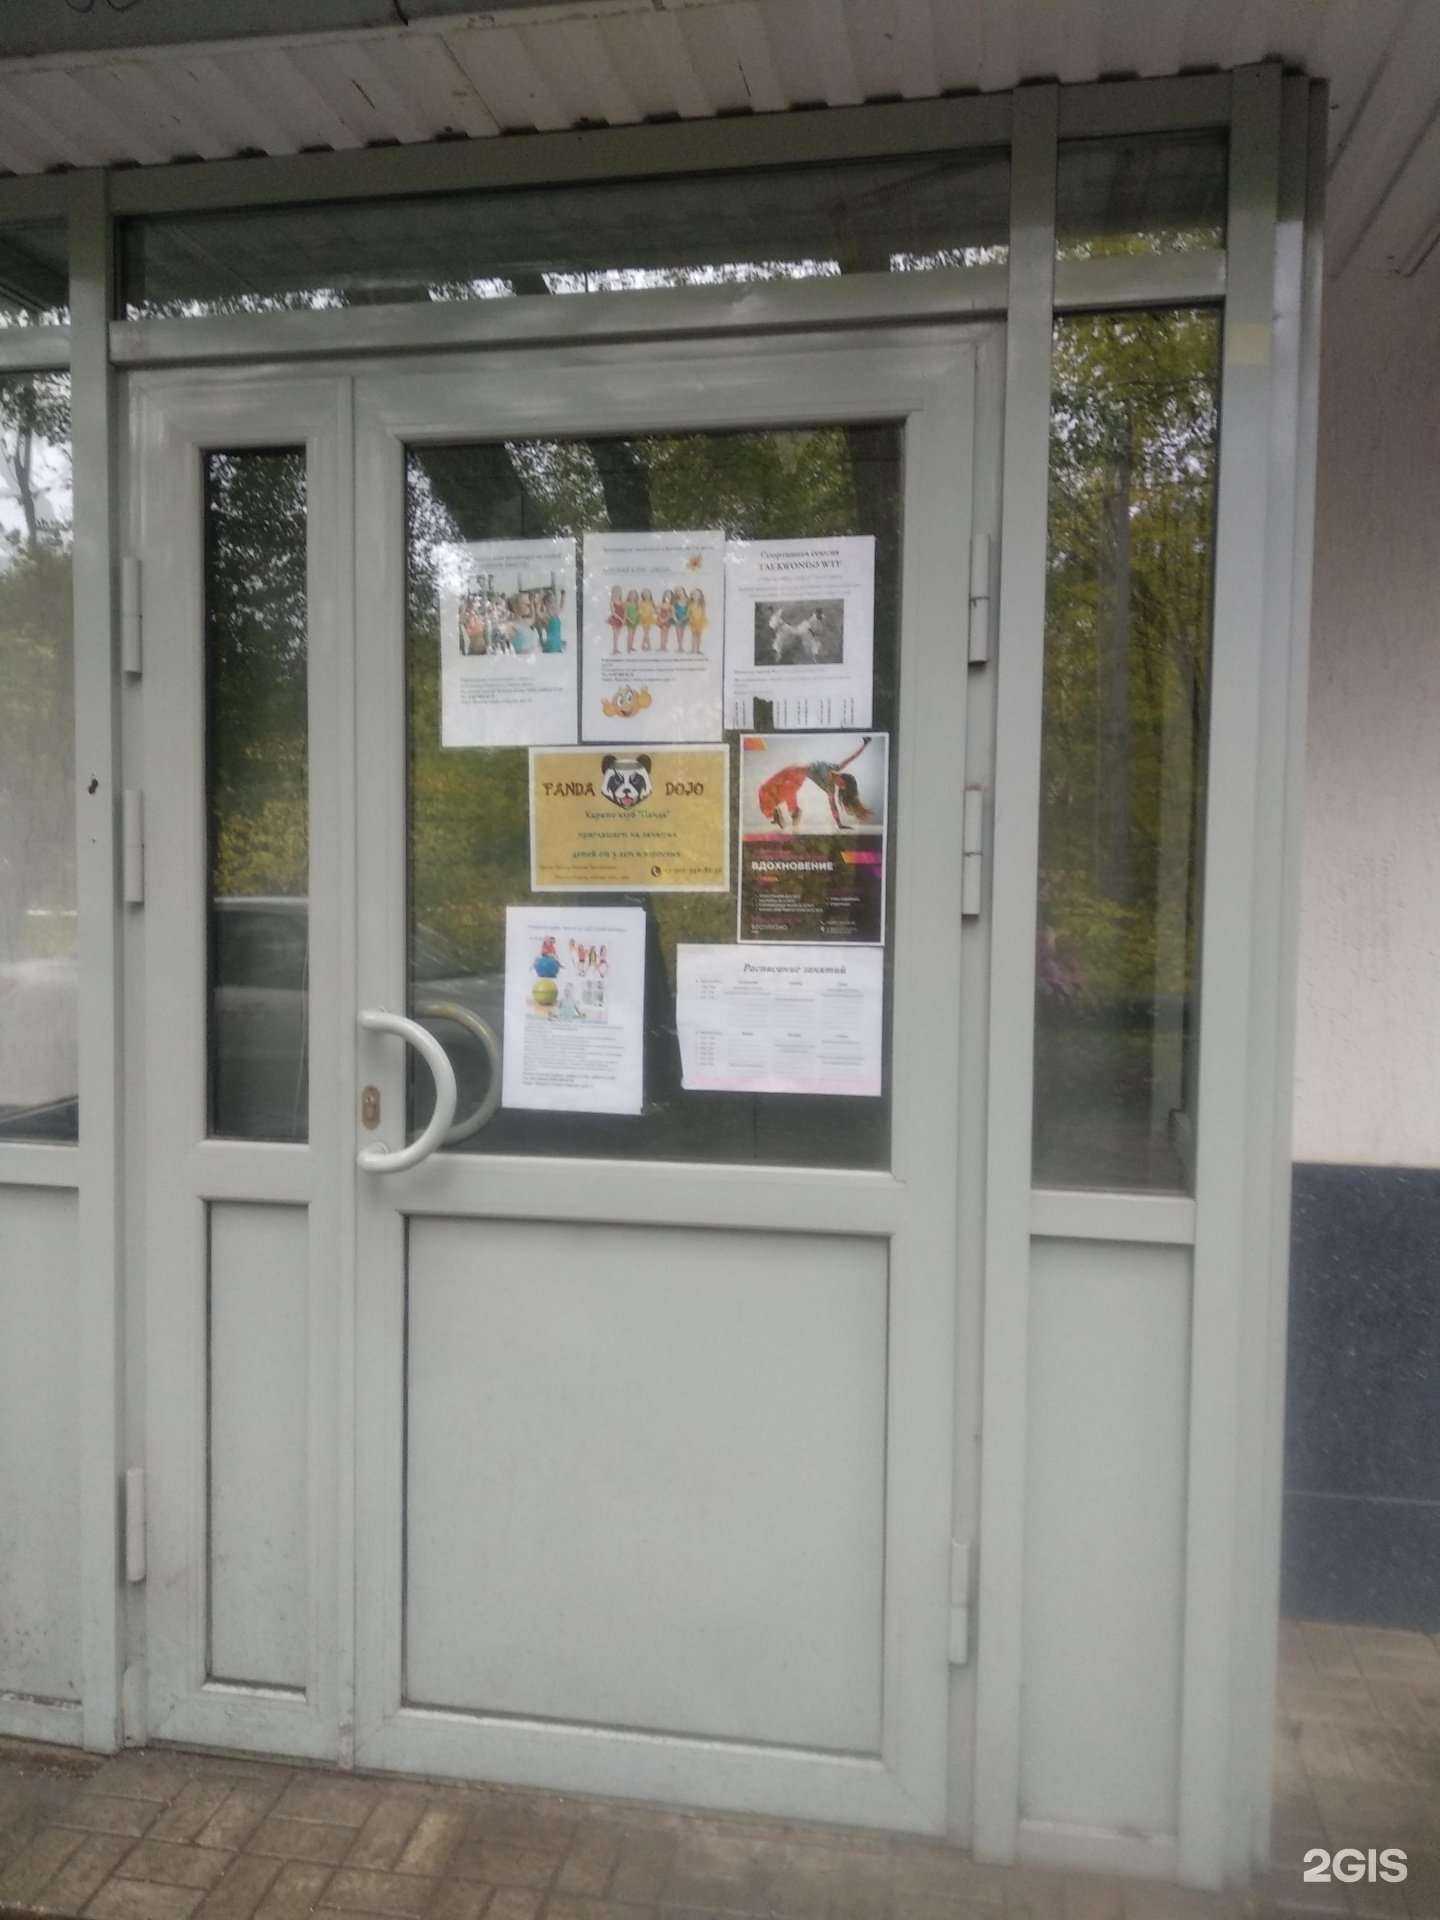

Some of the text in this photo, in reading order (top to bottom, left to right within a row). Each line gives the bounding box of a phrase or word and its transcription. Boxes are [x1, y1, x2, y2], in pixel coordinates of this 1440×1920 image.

[542, 781, 704, 797] PANDA DOJO
[751, 861, 834, 872] ВДОХНОВЕНИЕ
